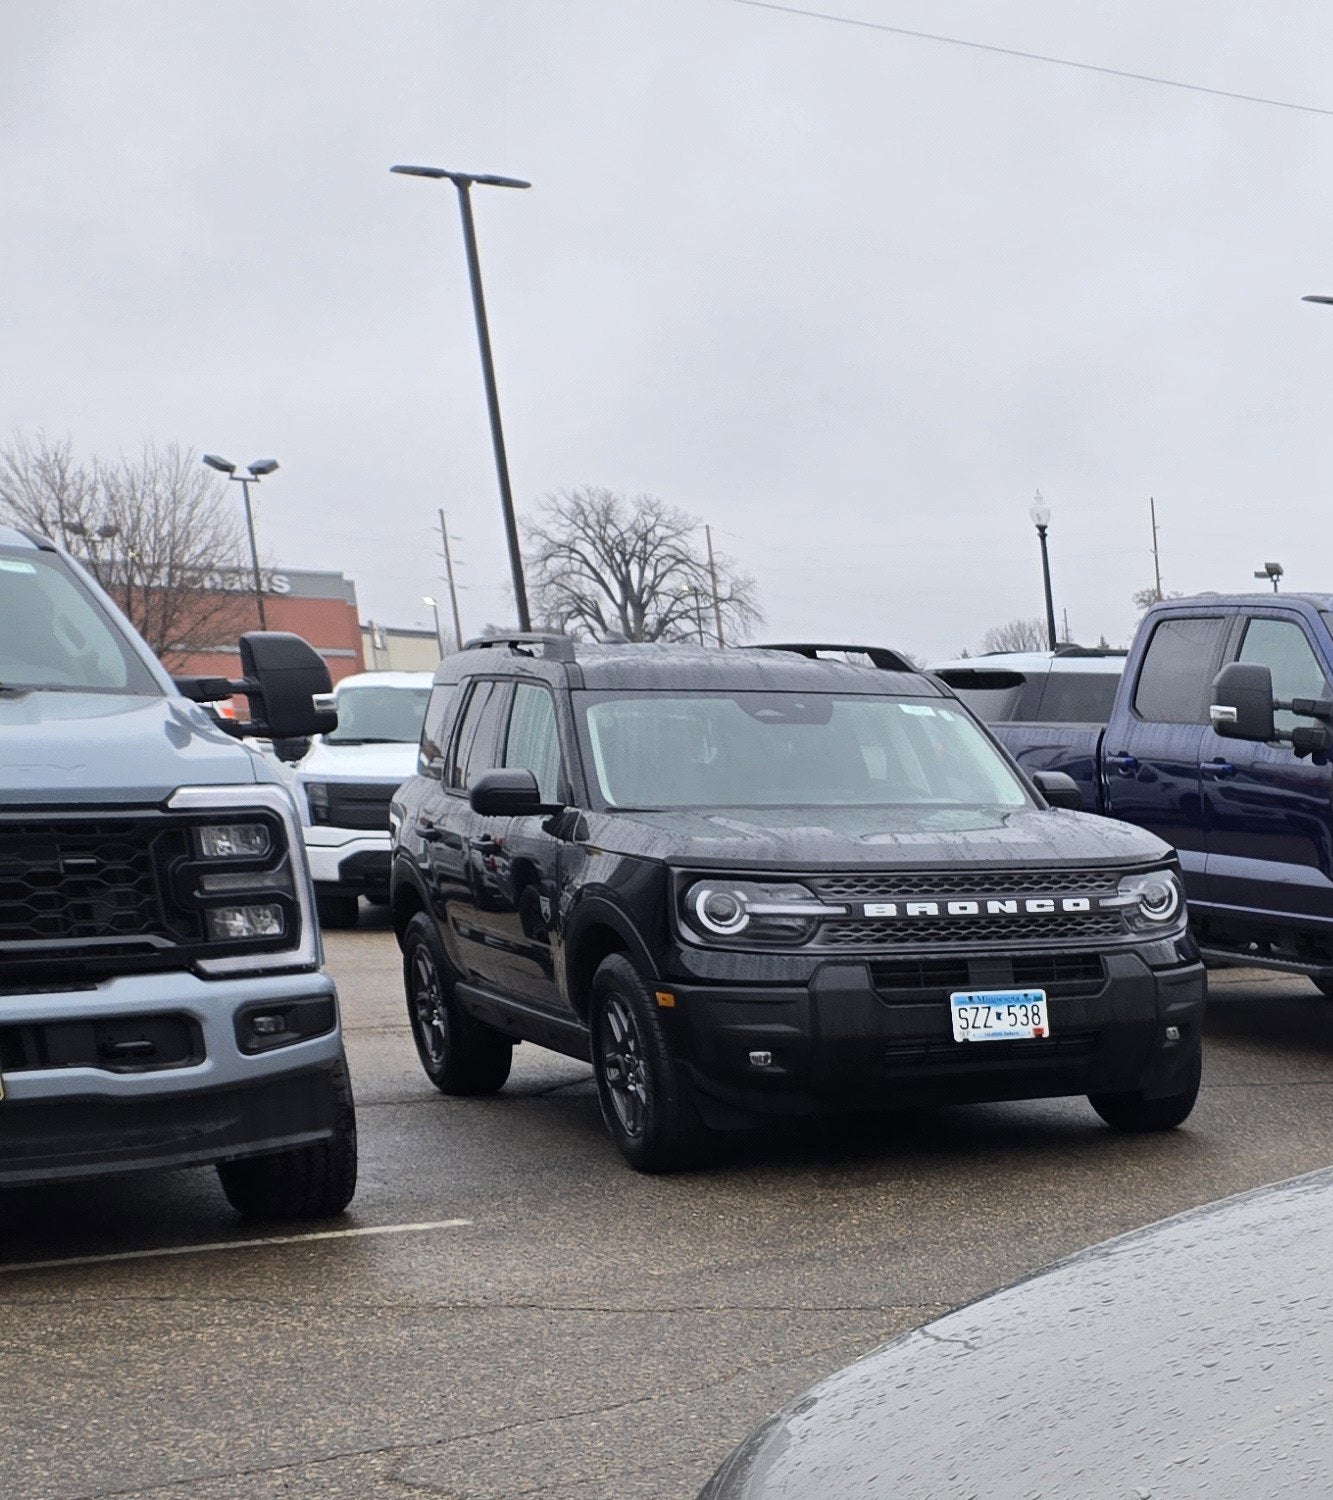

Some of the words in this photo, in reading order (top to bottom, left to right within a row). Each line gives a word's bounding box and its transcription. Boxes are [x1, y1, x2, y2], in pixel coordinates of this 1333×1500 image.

[863, 898, 1090, 917] BRONCO
[958, 1006, 993, 1030] SZZ
[1007, 1004, 1040, 1027] 538
